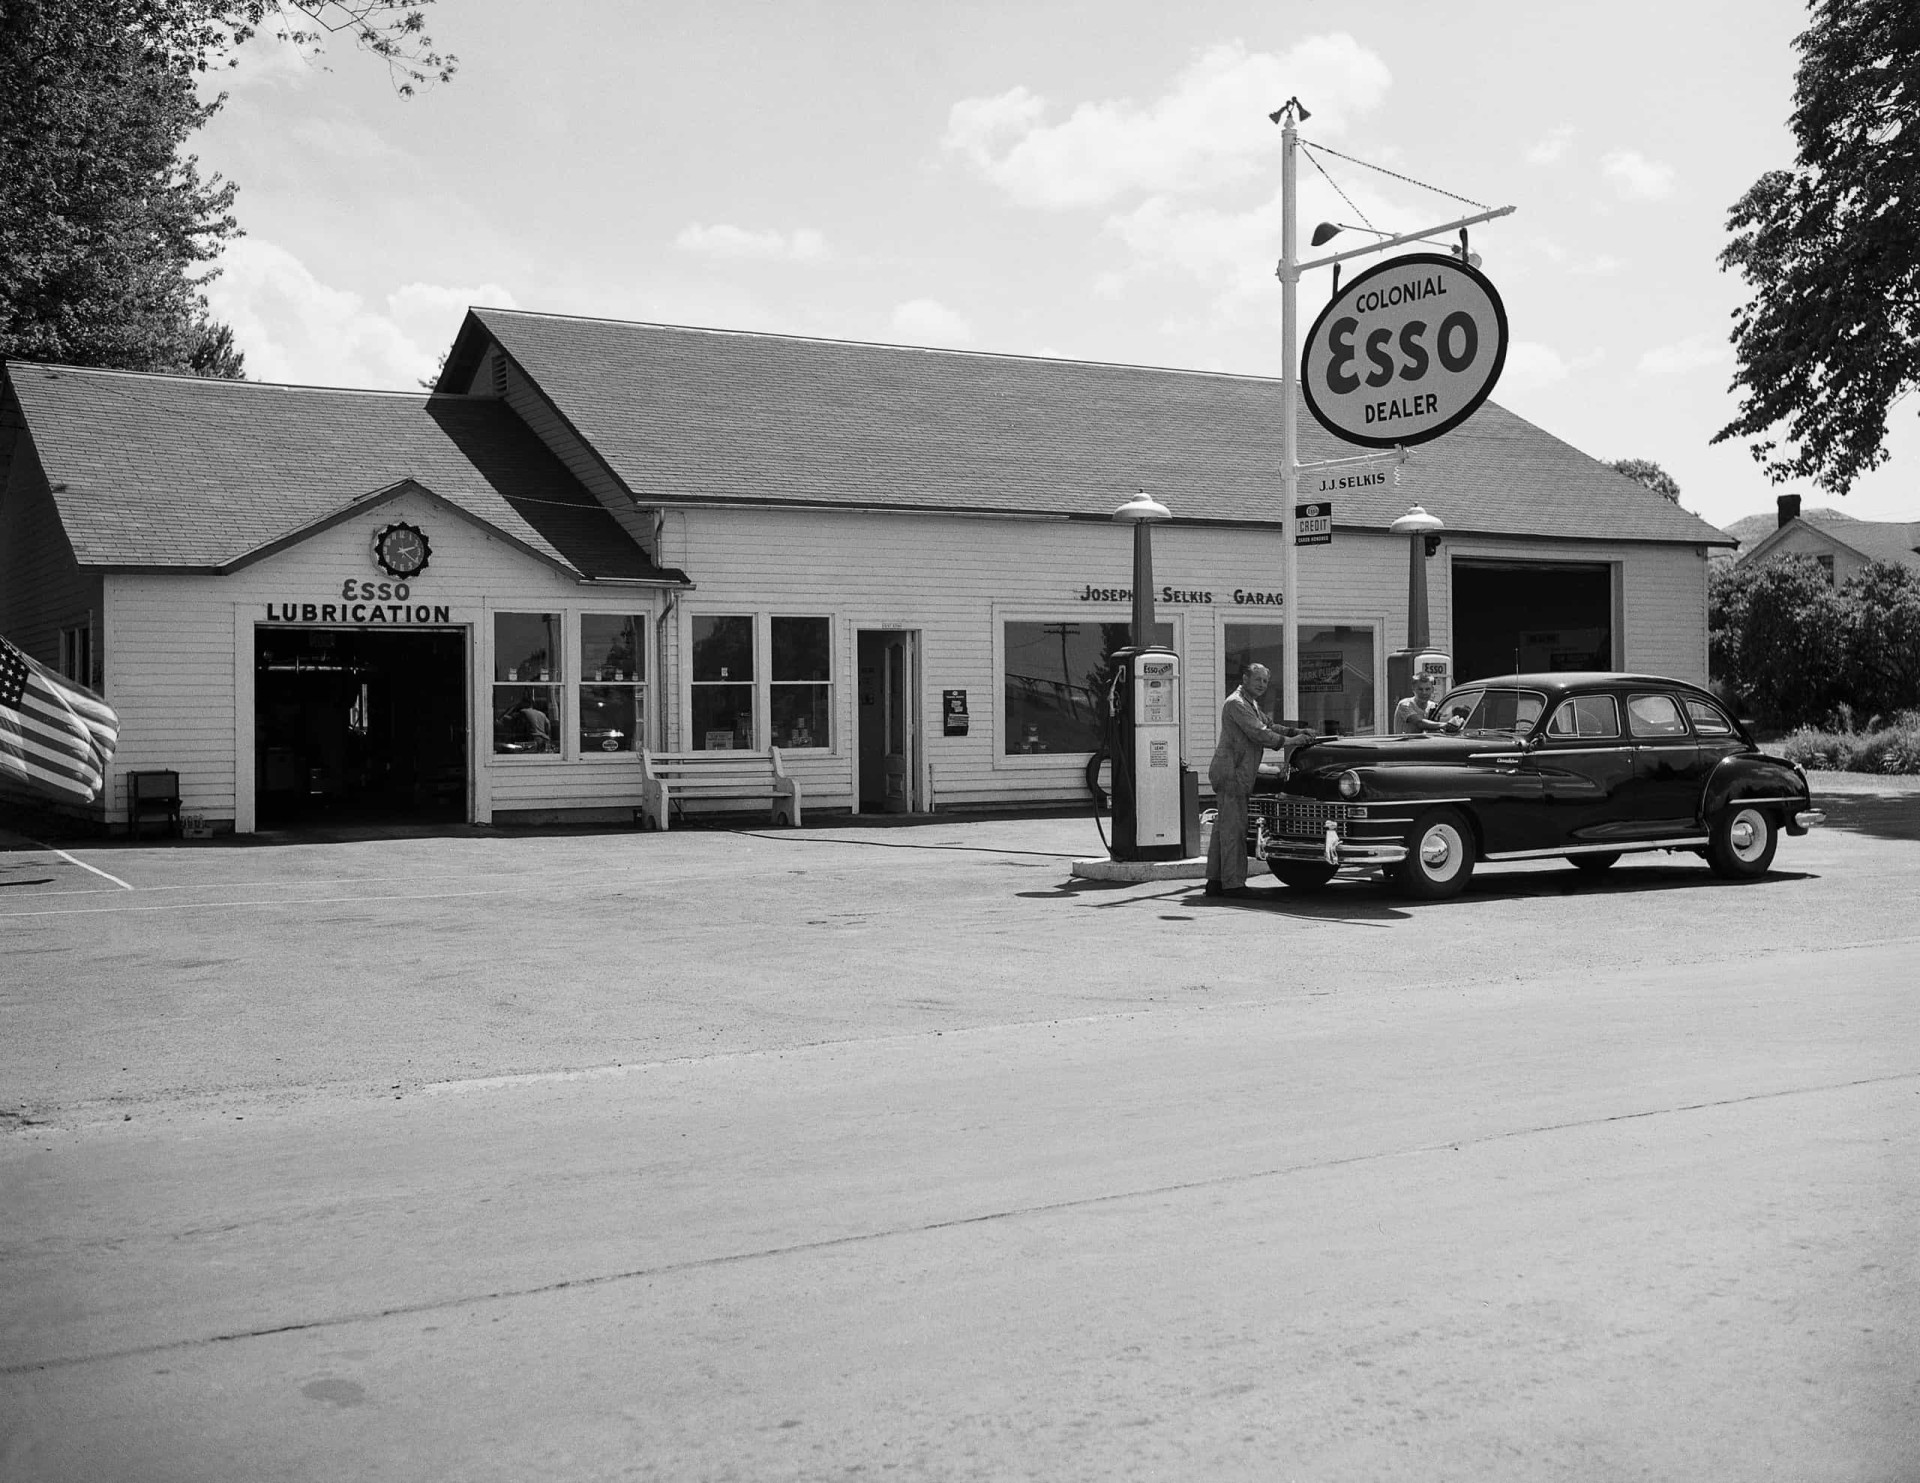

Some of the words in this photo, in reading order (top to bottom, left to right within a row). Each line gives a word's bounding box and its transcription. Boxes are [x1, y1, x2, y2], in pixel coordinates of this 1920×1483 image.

[1356, 275, 1447, 313] COLONIAL
[1326, 311, 1478, 394] ESSO
[1365, 393, 1438, 423] DEALER
[1299, 519, 1327, 532] CREDIT
[342, 578, 410, 601] ESSO
[1162, 587, 1212, 603] SELKIS
[1233, 589, 1283, 605] GARAG
[267, 603, 450, 623] LUBRICATION
[1425, 663, 1444, 674] ESSO
